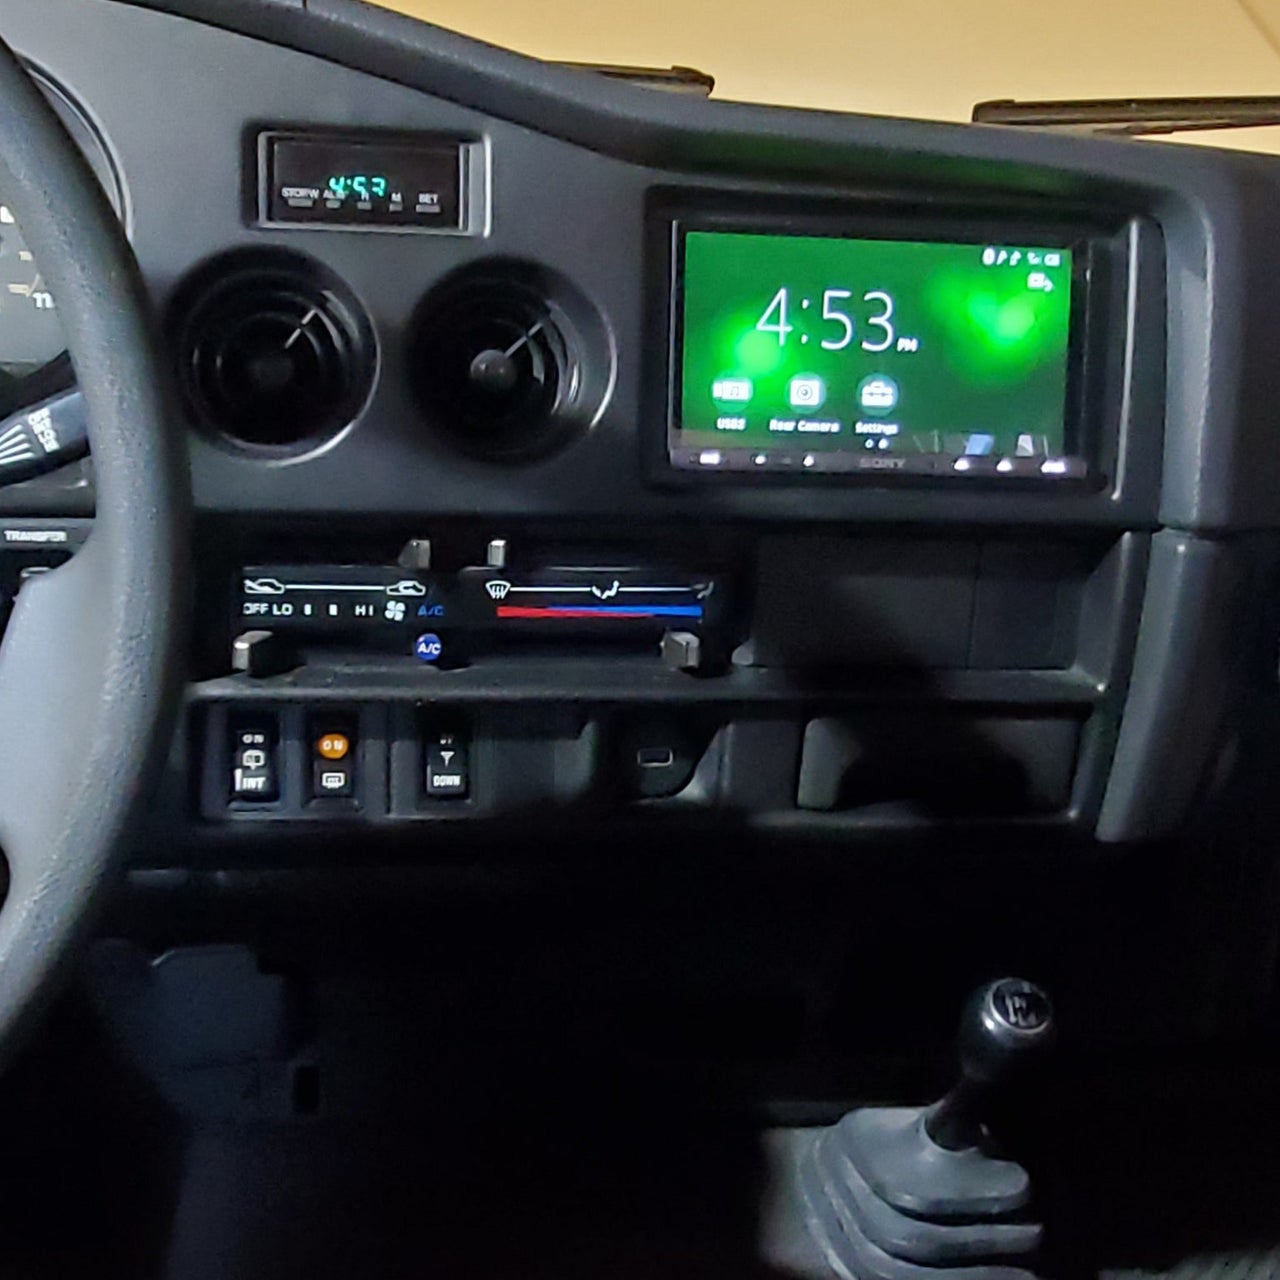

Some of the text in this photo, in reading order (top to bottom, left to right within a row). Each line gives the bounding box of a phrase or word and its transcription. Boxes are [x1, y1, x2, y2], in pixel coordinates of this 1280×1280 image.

[328, 176, 386, 197] 4:53
[755, 287, 919, 352] 4:53 PM
[770, 418, 840, 432] Rear Camera
[855, 420, 899, 435] Settings
[859, 457, 906, 469] SONY
[243, 603, 444, 617] OFF LO HI A/C
[417, 641, 441, 655] A/C
[322, 740, 344, 751] ON
[433, 775, 461, 787] DOWN
